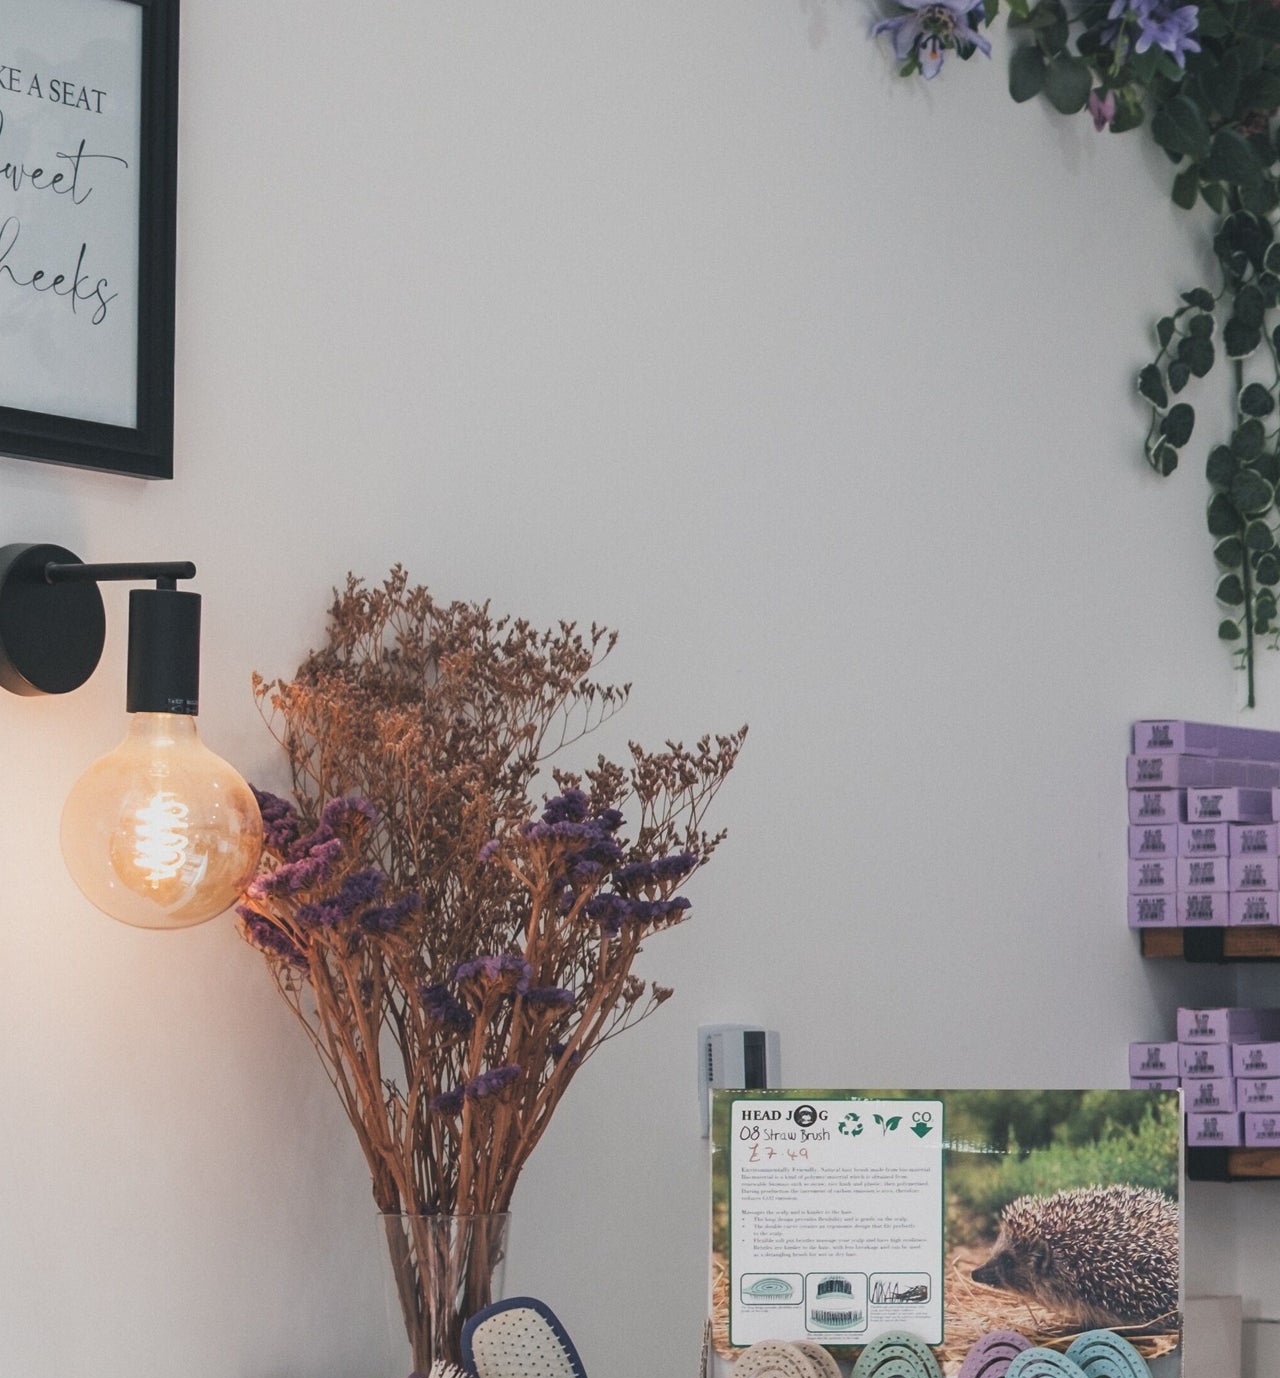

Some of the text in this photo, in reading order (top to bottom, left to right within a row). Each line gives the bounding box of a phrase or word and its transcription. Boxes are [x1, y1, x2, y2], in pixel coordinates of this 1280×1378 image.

[27, 73, 44, 99] A
[49, 79, 107, 114] SEAT
[741, 1110, 781, 1121] HEAD
[763, 1127, 797, 1141] Straw
[800, 1127, 830, 1143] Brush
